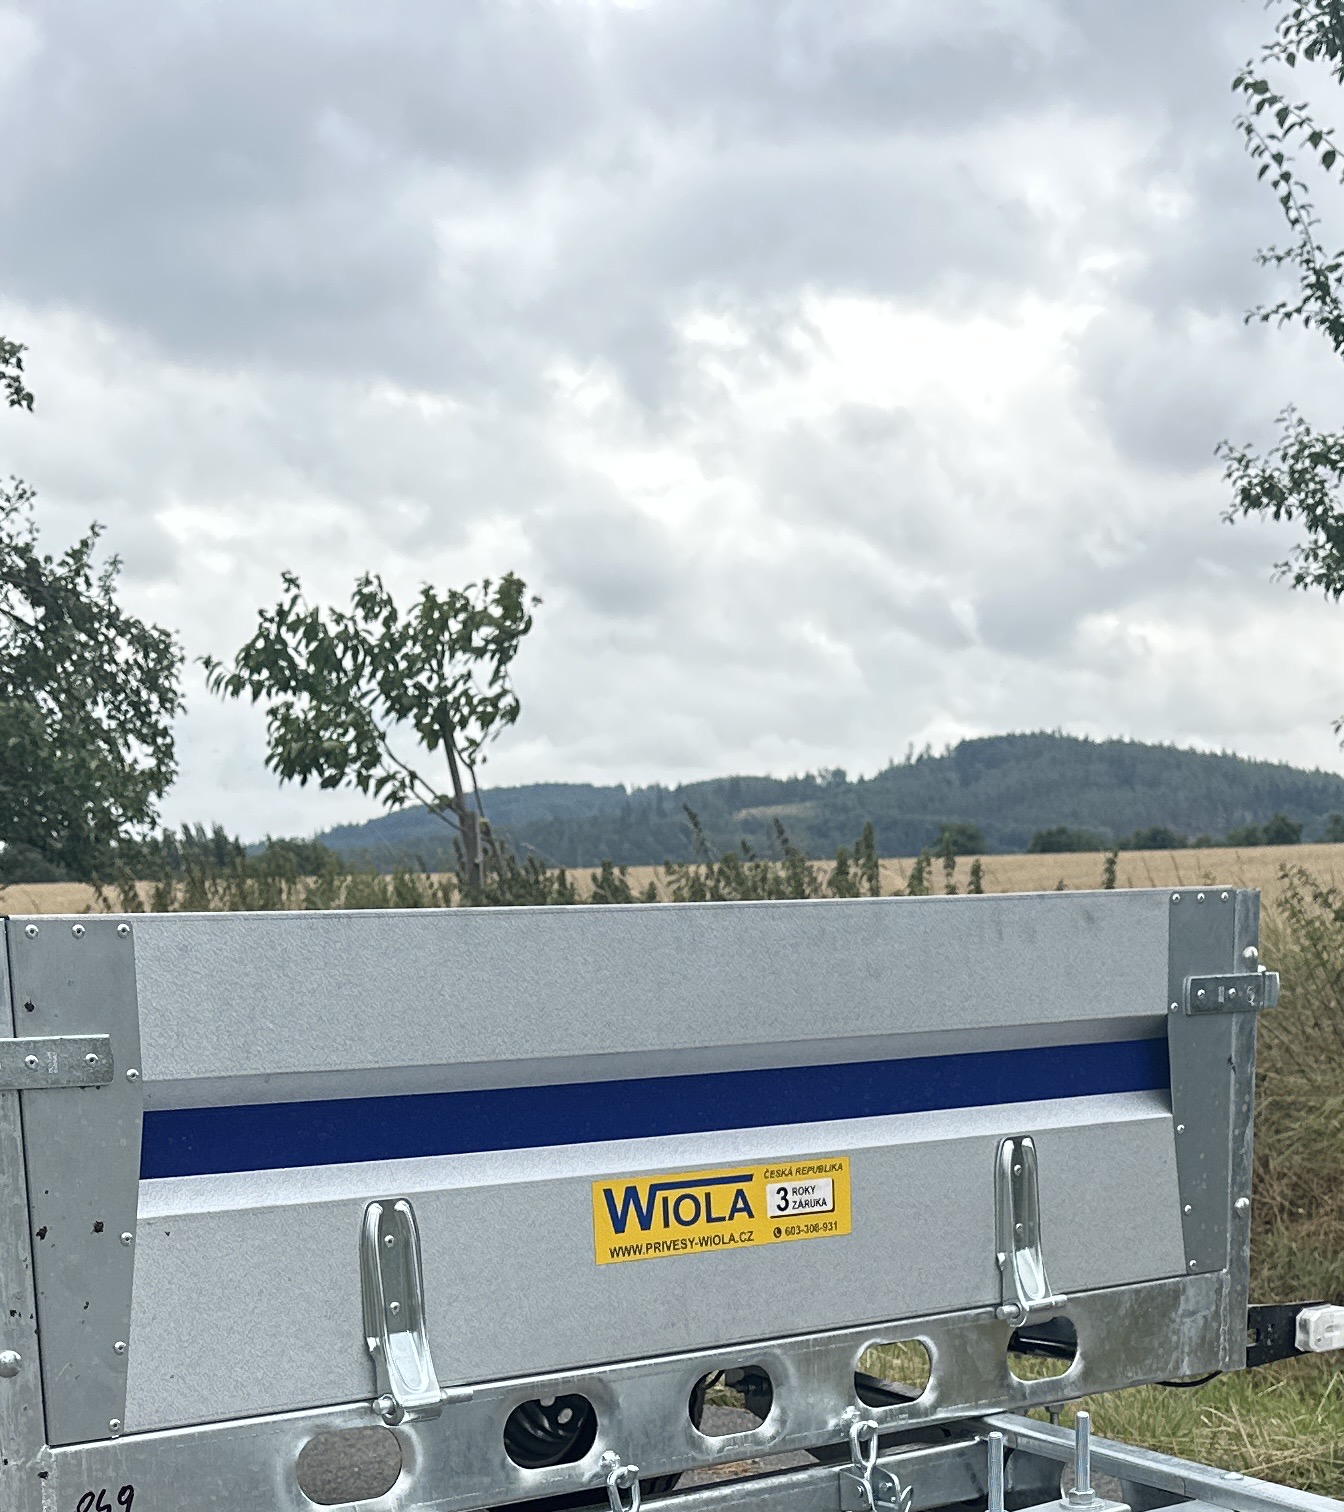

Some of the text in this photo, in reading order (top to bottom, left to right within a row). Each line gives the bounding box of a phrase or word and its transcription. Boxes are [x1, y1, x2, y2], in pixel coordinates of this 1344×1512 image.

[763, 1163, 843, 1180] ČESKÁ REPUBLIKA
[775, 1184, 816, 1212] 3 ROKY
[792, 1197, 827, 1210] ZÁRUKA
[609, 1231, 755, 1259] WWW.PRIVESY-WIOLA.CZ
